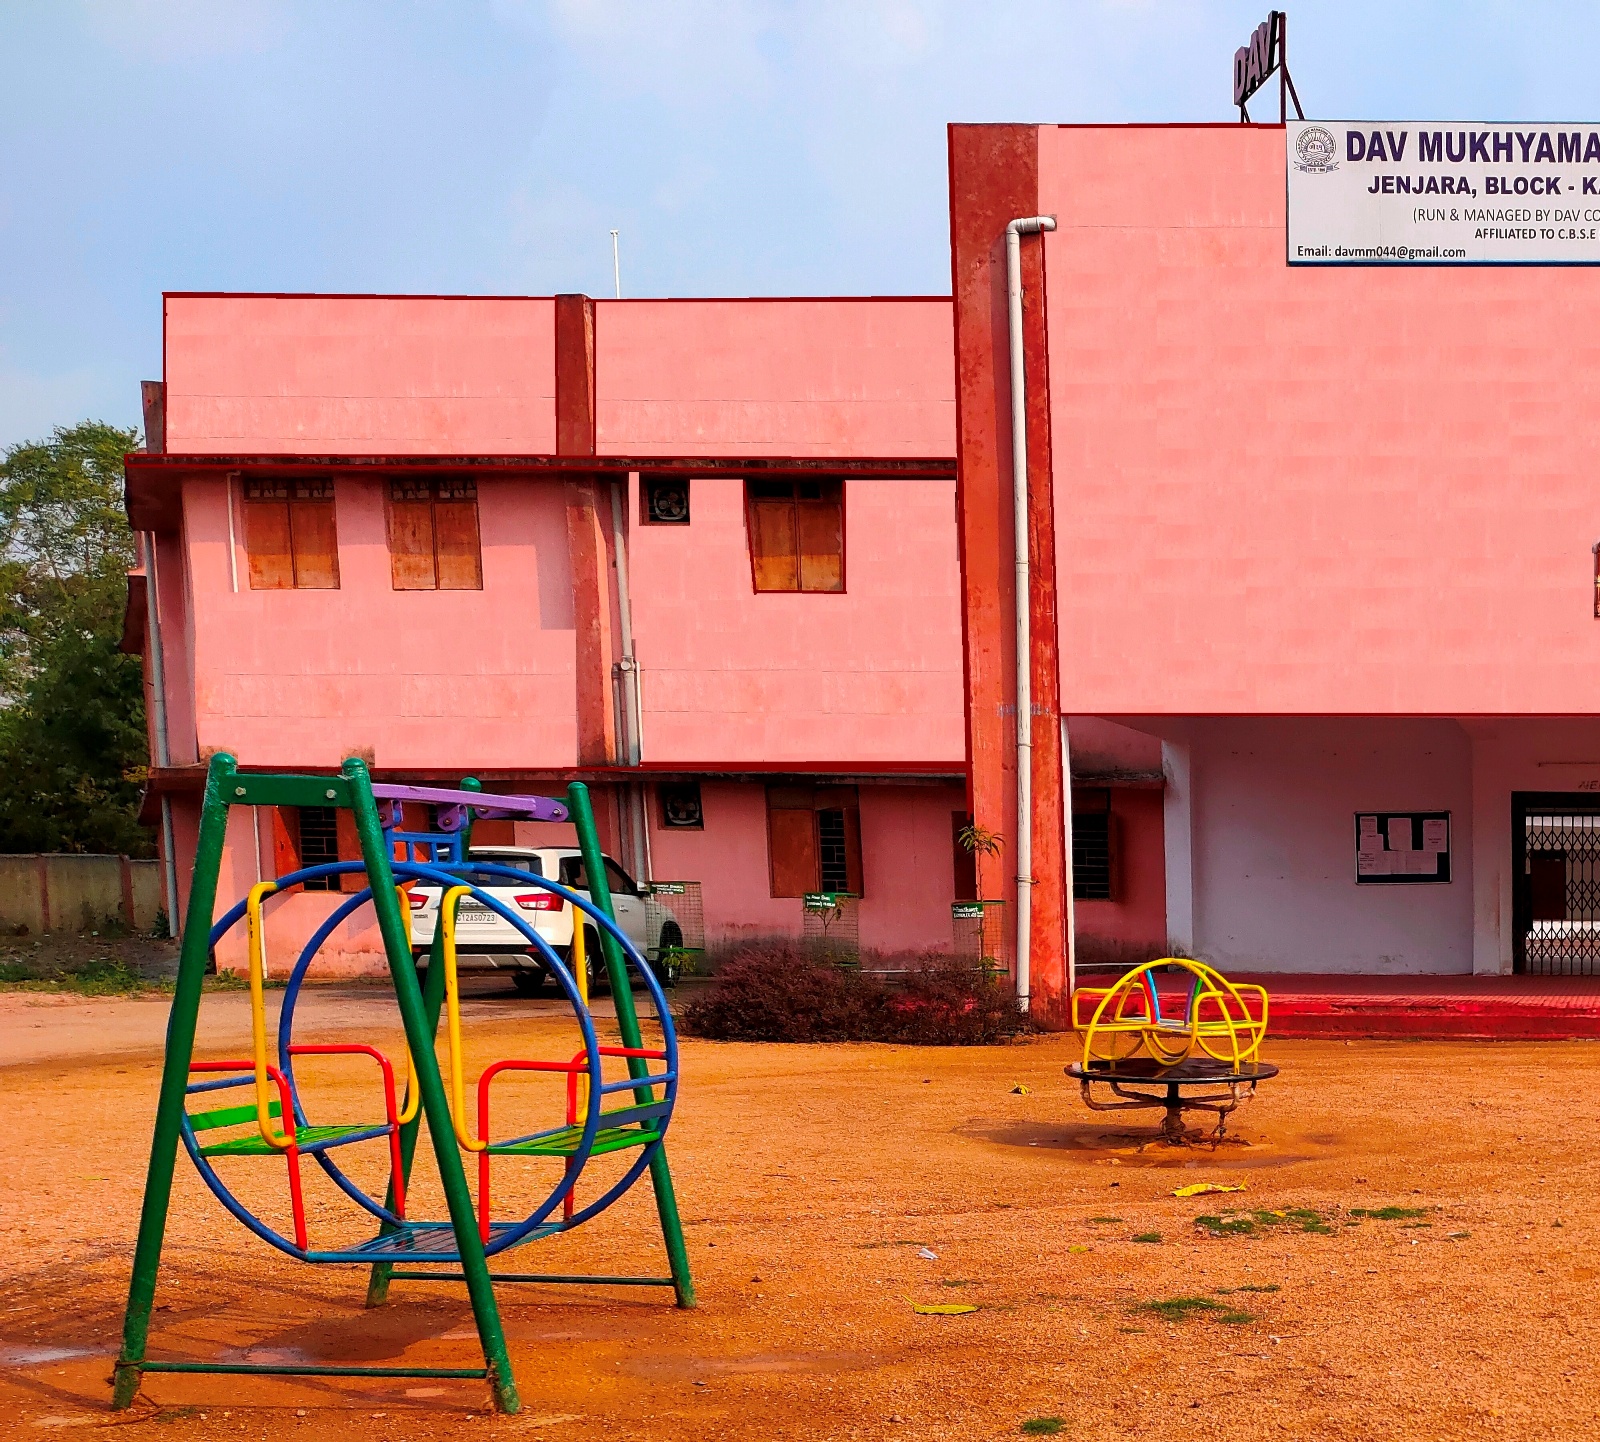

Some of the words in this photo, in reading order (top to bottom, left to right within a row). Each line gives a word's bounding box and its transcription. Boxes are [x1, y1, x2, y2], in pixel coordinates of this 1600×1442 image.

[1234, 10, 1278, 106] DAV
[1347, 131, 1408, 161] DAV
[1368, 176, 1476, 199] JENJARA,
[1486, 177, 1561, 195] BLOCK
[1413, 207, 1446, 224] (RUN
[1450, 209, 1459, 221] &
[1464, 208, 1532, 222] MANAGED
[1535, 209, 1551, 222] BY
[1554, 209, 1581, 222] DAV
[1474, 227, 1537, 240] AFFILIATED
[1539, 228, 1555, 240] TO
[1557, 228, 1597, 240] C.B.S.E
[1297, 244, 1332, 257] Email:
[1334, 244, 1466, 261] davmm044@gmail.com
[457, 913, 496, 922] G12AS0723
